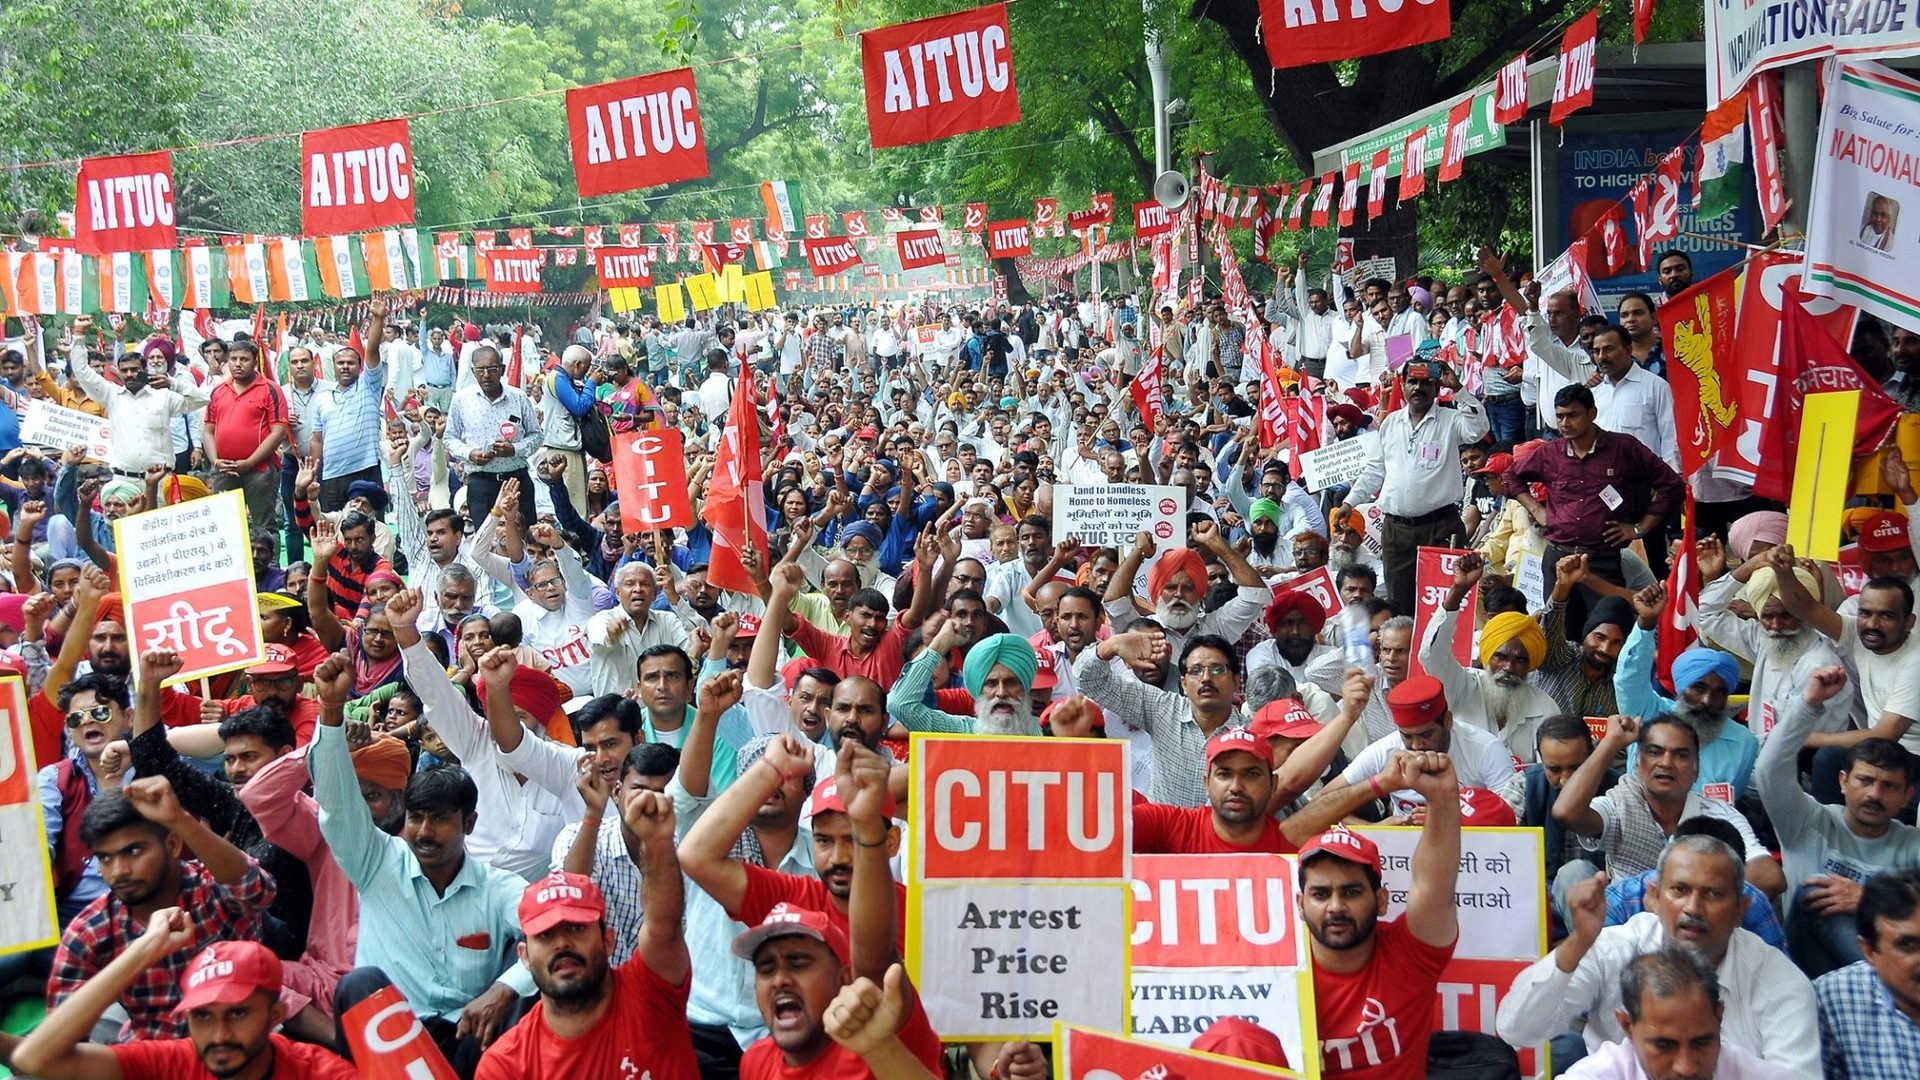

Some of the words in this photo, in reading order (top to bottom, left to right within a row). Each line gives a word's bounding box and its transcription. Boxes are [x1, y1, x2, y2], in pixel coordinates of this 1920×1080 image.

[883, 25, 1009, 113] AITUC
[586, 87, 696, 165] AITUC
[1840, 104, 1858, 120] Big
[1860, 110, 1893, 131] Salute
[1894, 122, 1913, 139] for
[1574, 149, 1640, 170] INDIA
[1829, 128, 1920, 188] NATIONAL
[309, 142, 410, 208] AITUC
[1574, 176, 1597, 188] TO
[87, 173, 174, 230] AITUC
[1676, 213, 1736, 233] VINGS
[903, 234, 943, 261] AITUC
[994, 226, 1030, 250] AITUC
[812, 241, 857, 267] AITUC
[493, 257, 541, 283] AITUC
[603, 255, 649, 279] AITUC
[32, 432, 63, 448] AITUC
[631, 436, 671, 523] CITU
[1074, 486, 1094, 495] Land
[1096, 486, 1105, 495] to
[1107, 486, 1146, 495] Landless
[1318, 473, 1344, 489] AITUC
[1069, 497, 1094, 506] Home
[1096, 497, 1105, 506] to
[1107, 496, 1151, 506] Homeless
[1066, 508, 1112, 521] भूमिहीनों
[1114, 509, 1128, 518] को
[1131, 509, 1152, 521] भूमि
[1108, 521, 1122, 530] को
[1113, 531, 1136, 544] एट
[1873, 526, 1900, 537] CITU
[1364, 534, 1382, 555] ITUC
[142, 600, 249, 656] सीटू
[1219, 732, 1255, 743] CITU
[934, 768, 1116, 853] CITU
[1320, 832, 1362, 849] CITU
[1484, 851, 1511, 875] को
[536, 885, 583, 905] CITU
[957, 901, 1082, 930] Arrest
[187, 957, 234, 987] CITU
[971, 947, 1068, 974] Price
[980, 991, 1059, 1020] Rise
